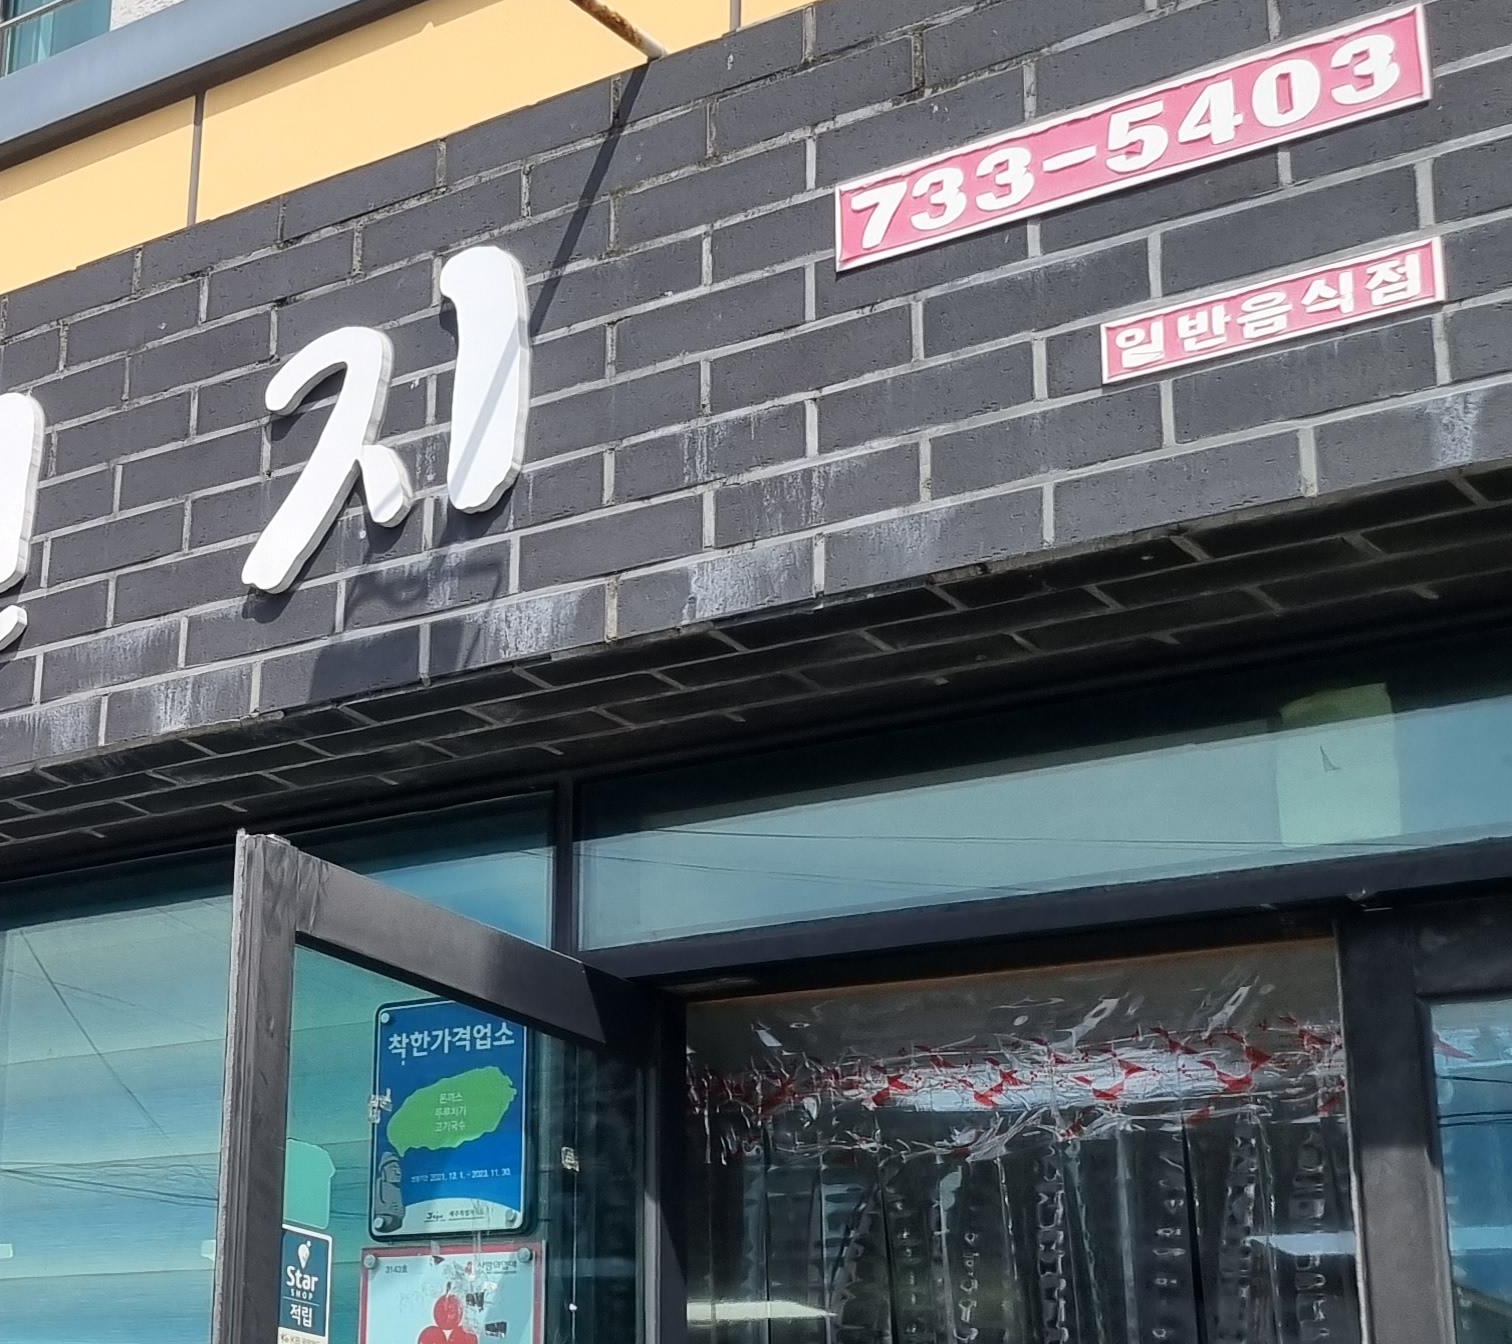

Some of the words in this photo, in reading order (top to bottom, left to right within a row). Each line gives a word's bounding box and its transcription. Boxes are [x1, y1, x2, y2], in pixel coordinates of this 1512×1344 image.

[849, 32, 1400, 250] 733-5403
[1114, 254, 1422, 369] 일반음식점
[388, 1022, 515, 1066] 착한가격업소
[286, 1265, 319, 1292] Star
[290, 1289, 313, 1300] SHOP
[290, 1303, 313, 1328] 적립
